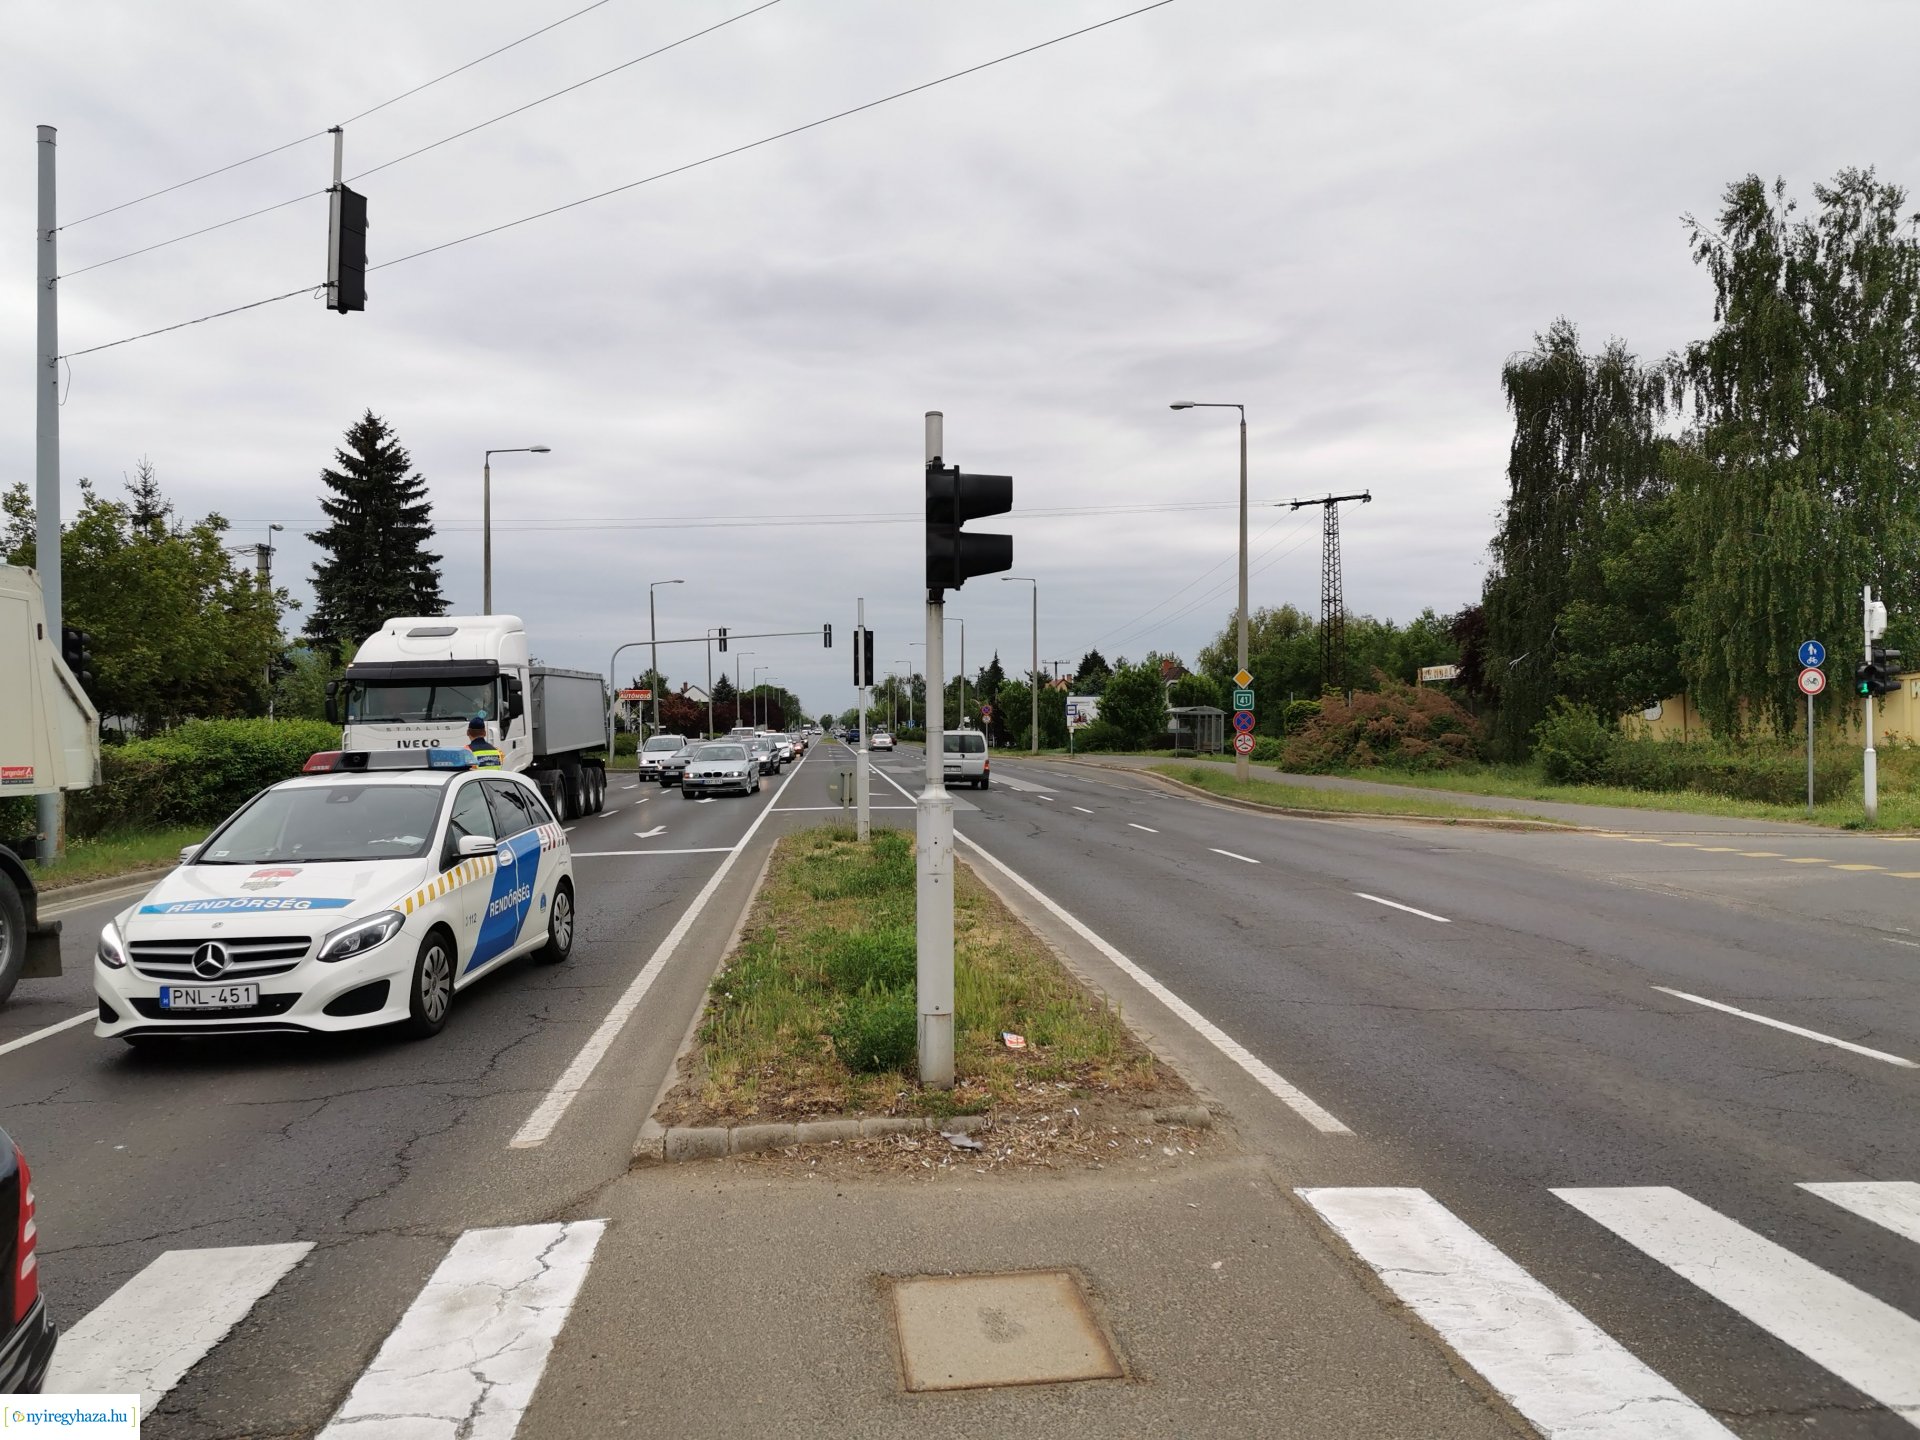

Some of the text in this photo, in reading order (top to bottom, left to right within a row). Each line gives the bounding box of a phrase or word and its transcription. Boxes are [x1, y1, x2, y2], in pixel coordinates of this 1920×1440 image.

[1240, 696, 1248, 704] 41
[397, 739, 440, 749] IVECO
[165, 897, 312, 914] RENDŐRSÉG
[489, 882, 531, 918] RENDŐRSÉG
[469, 913, 477, 926] 112
[173, 987, 250, 1005] PNL-451
